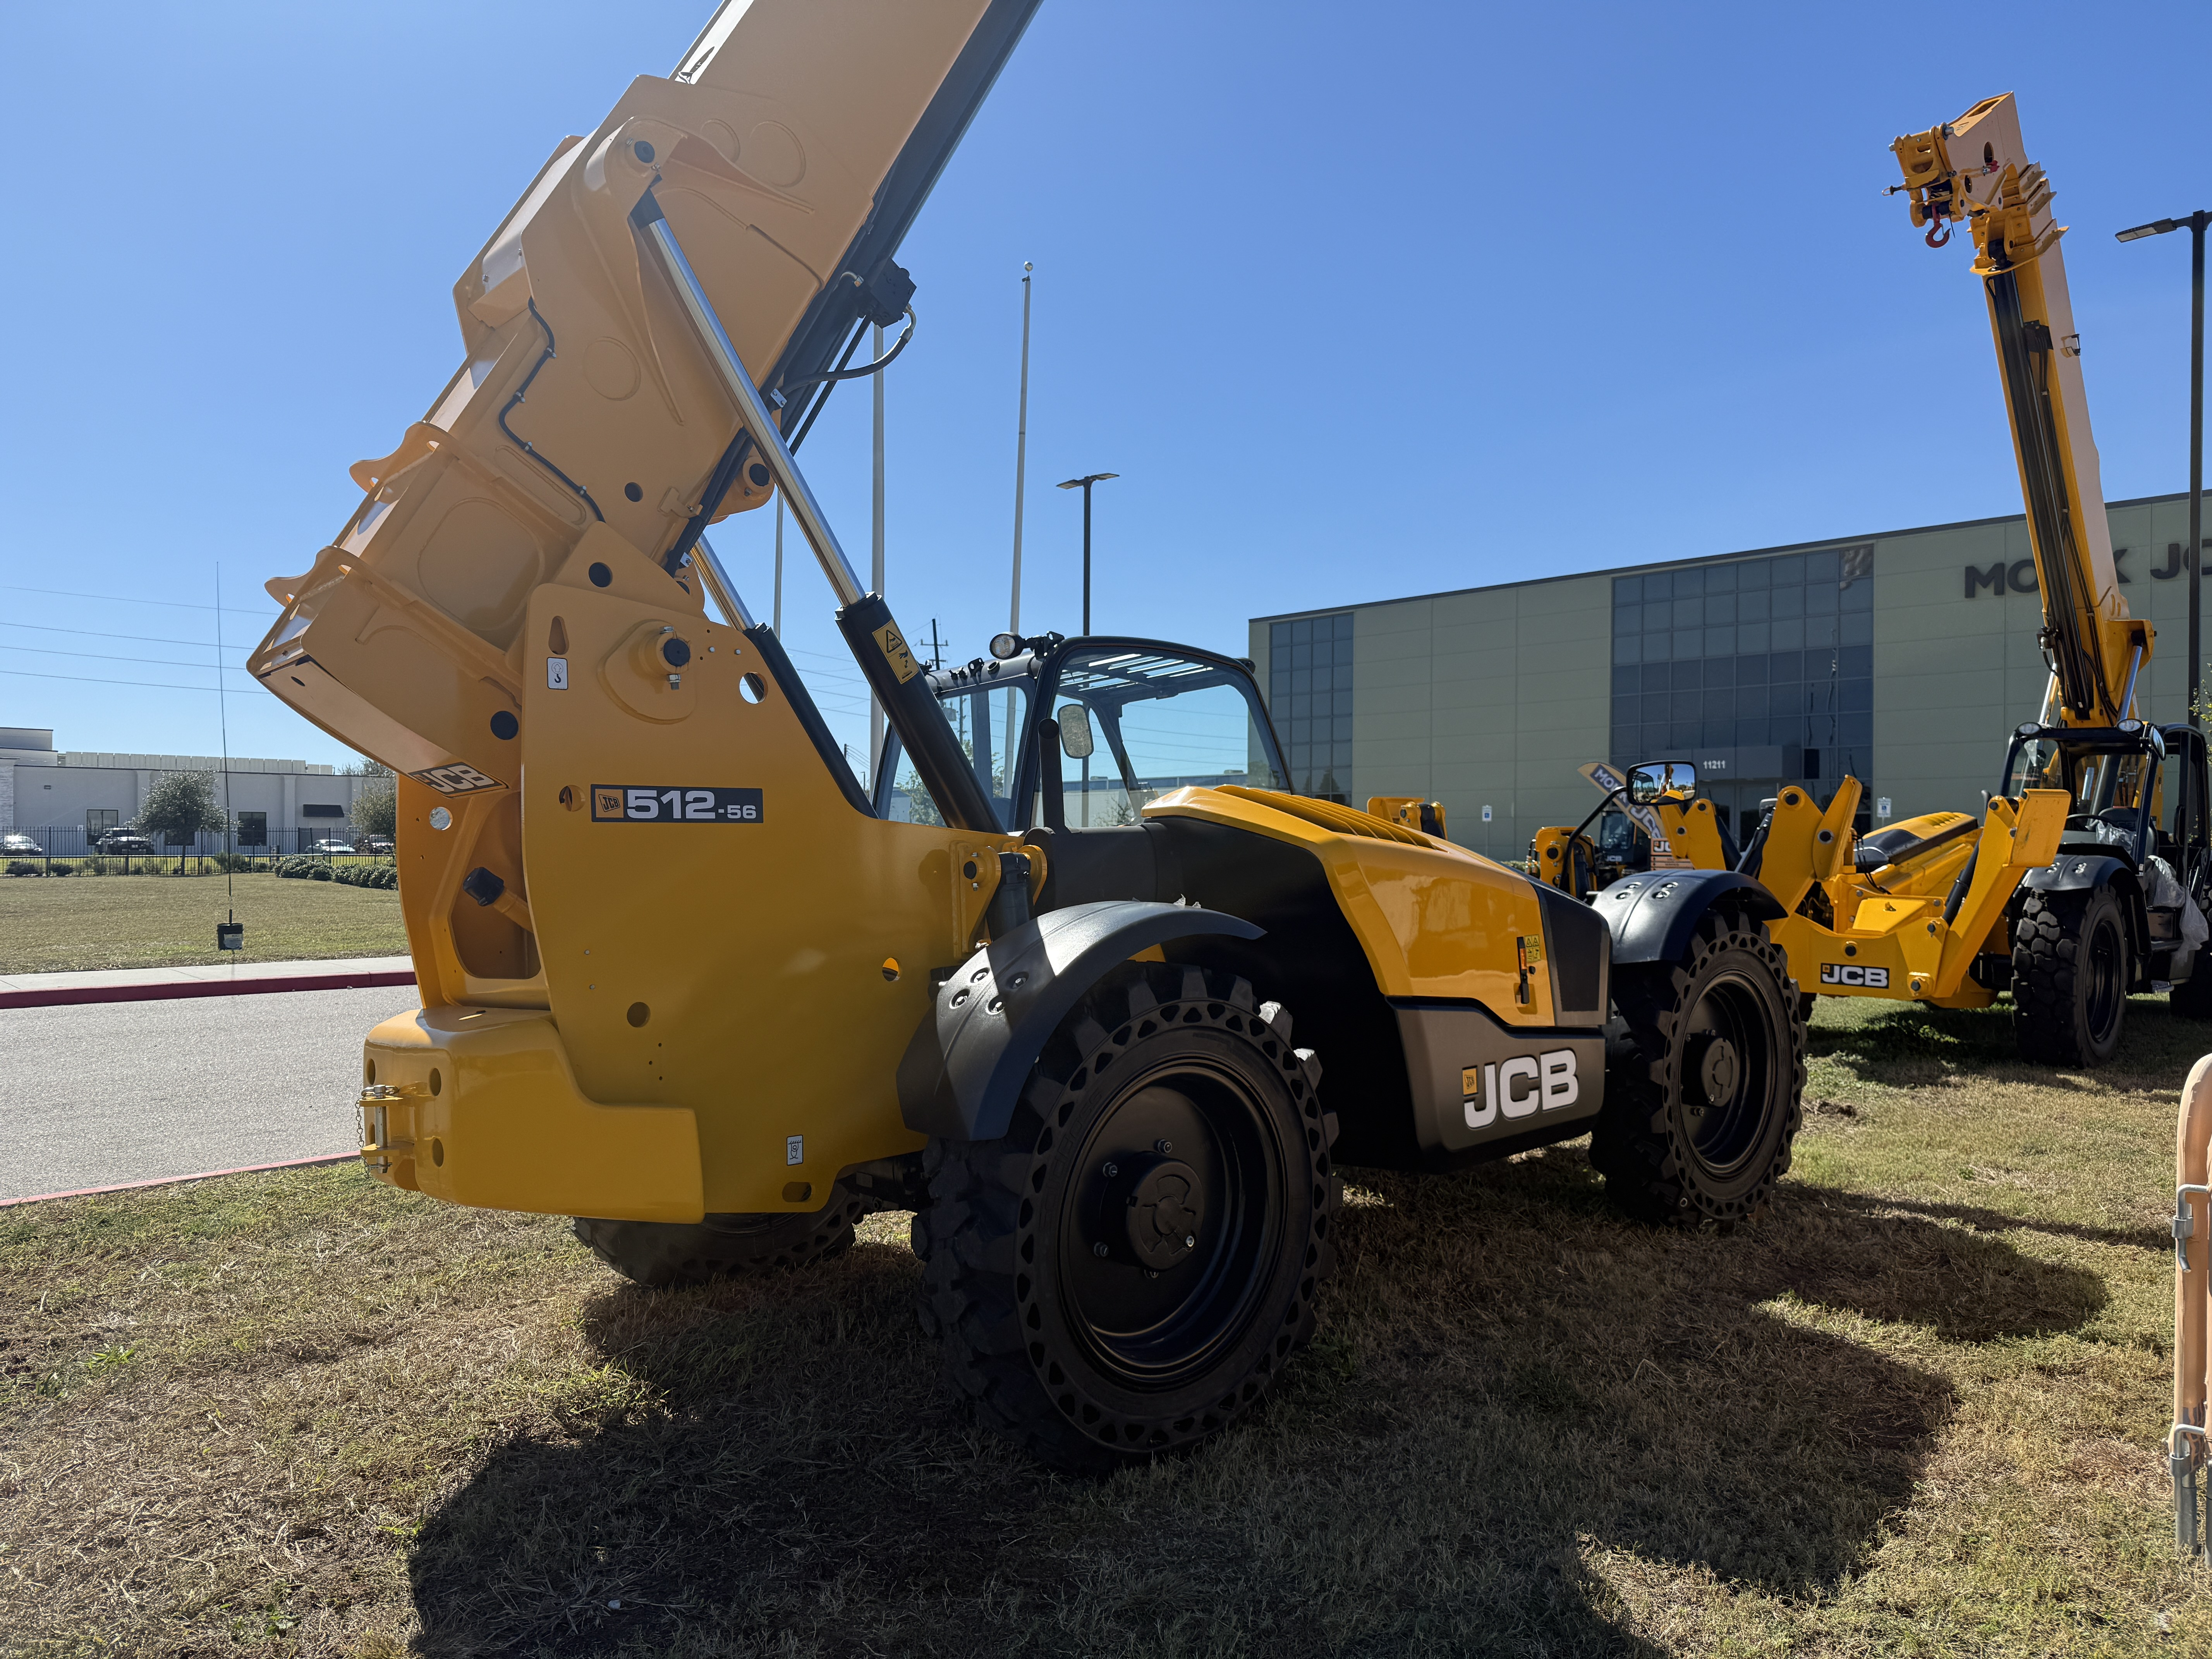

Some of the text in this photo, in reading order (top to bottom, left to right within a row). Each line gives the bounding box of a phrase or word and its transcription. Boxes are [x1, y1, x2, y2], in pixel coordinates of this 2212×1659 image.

[1965, 549, 2131, 599] MOK
[422, 765, 495, 792] JCB
[1703, 760, 1726, 769] 11211
[603, 789, 756, 819] JCB 512-56
[1822, 965, 1888, 987] JCB
[1464, 1049, 1578, 1128] JCB
